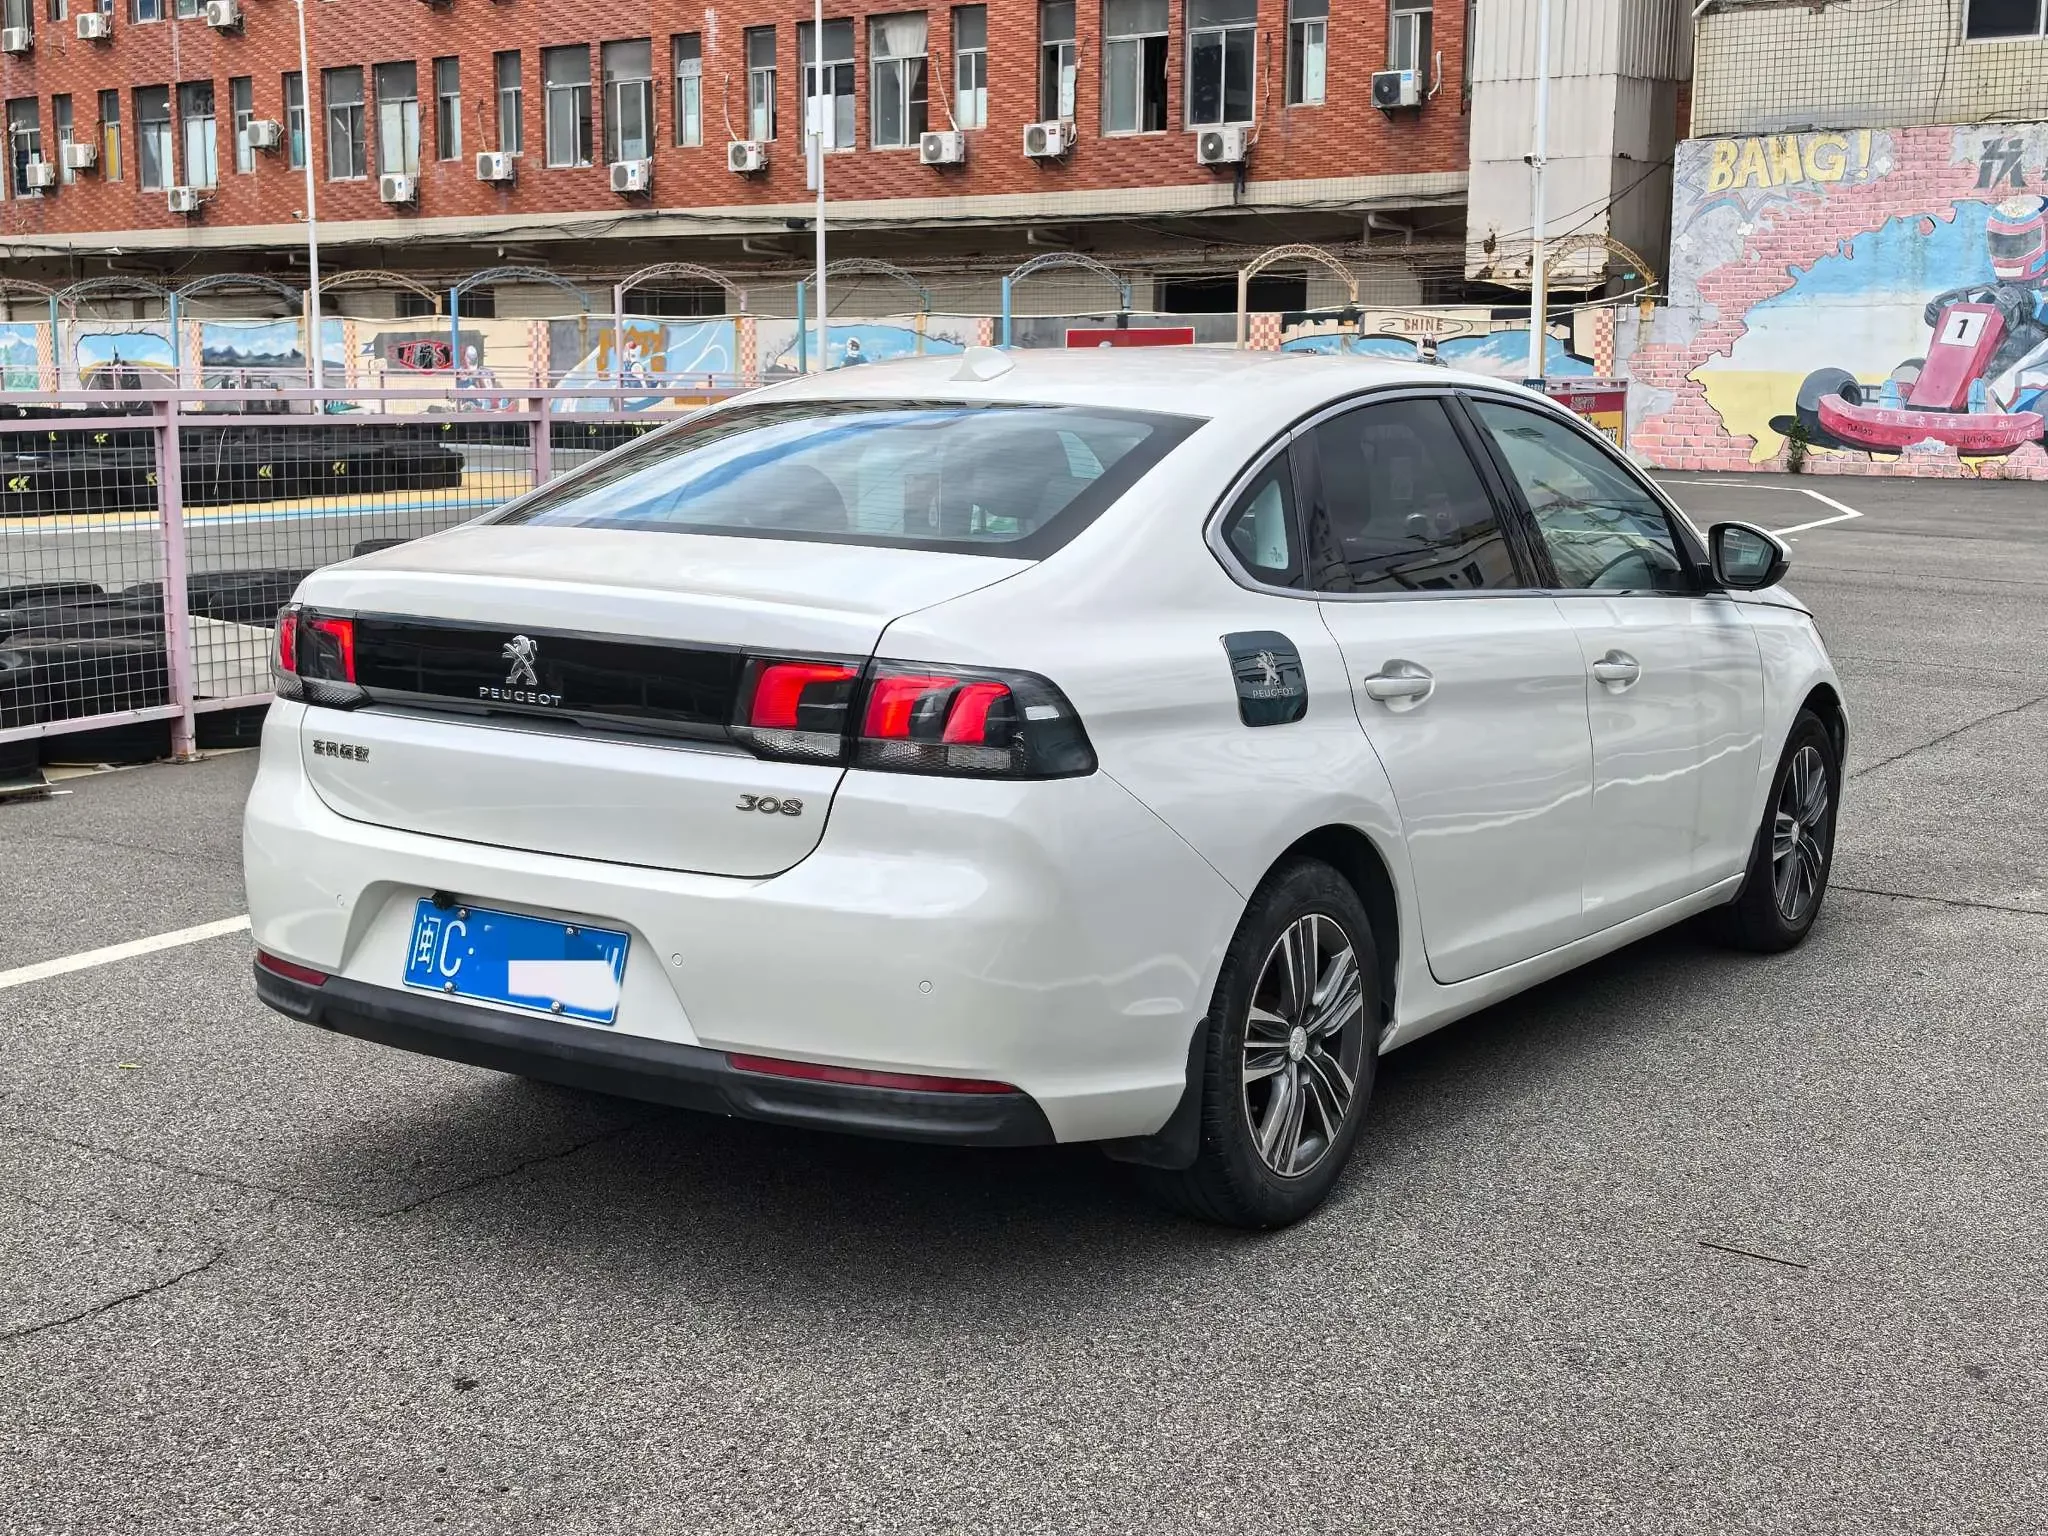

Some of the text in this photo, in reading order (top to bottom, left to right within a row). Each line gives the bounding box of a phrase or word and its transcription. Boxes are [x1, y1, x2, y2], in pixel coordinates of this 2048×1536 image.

[1707, 129, 1872, 193] BANG!
[1404, 318, 1444, 331] SHINE
[1957, 318, 1969, 339] 1
[479, 686, 562, 706] PEUGEOT
[1252, 687, 1294, 699] PEUGEOT
[735, 794, 804, 817] 308
